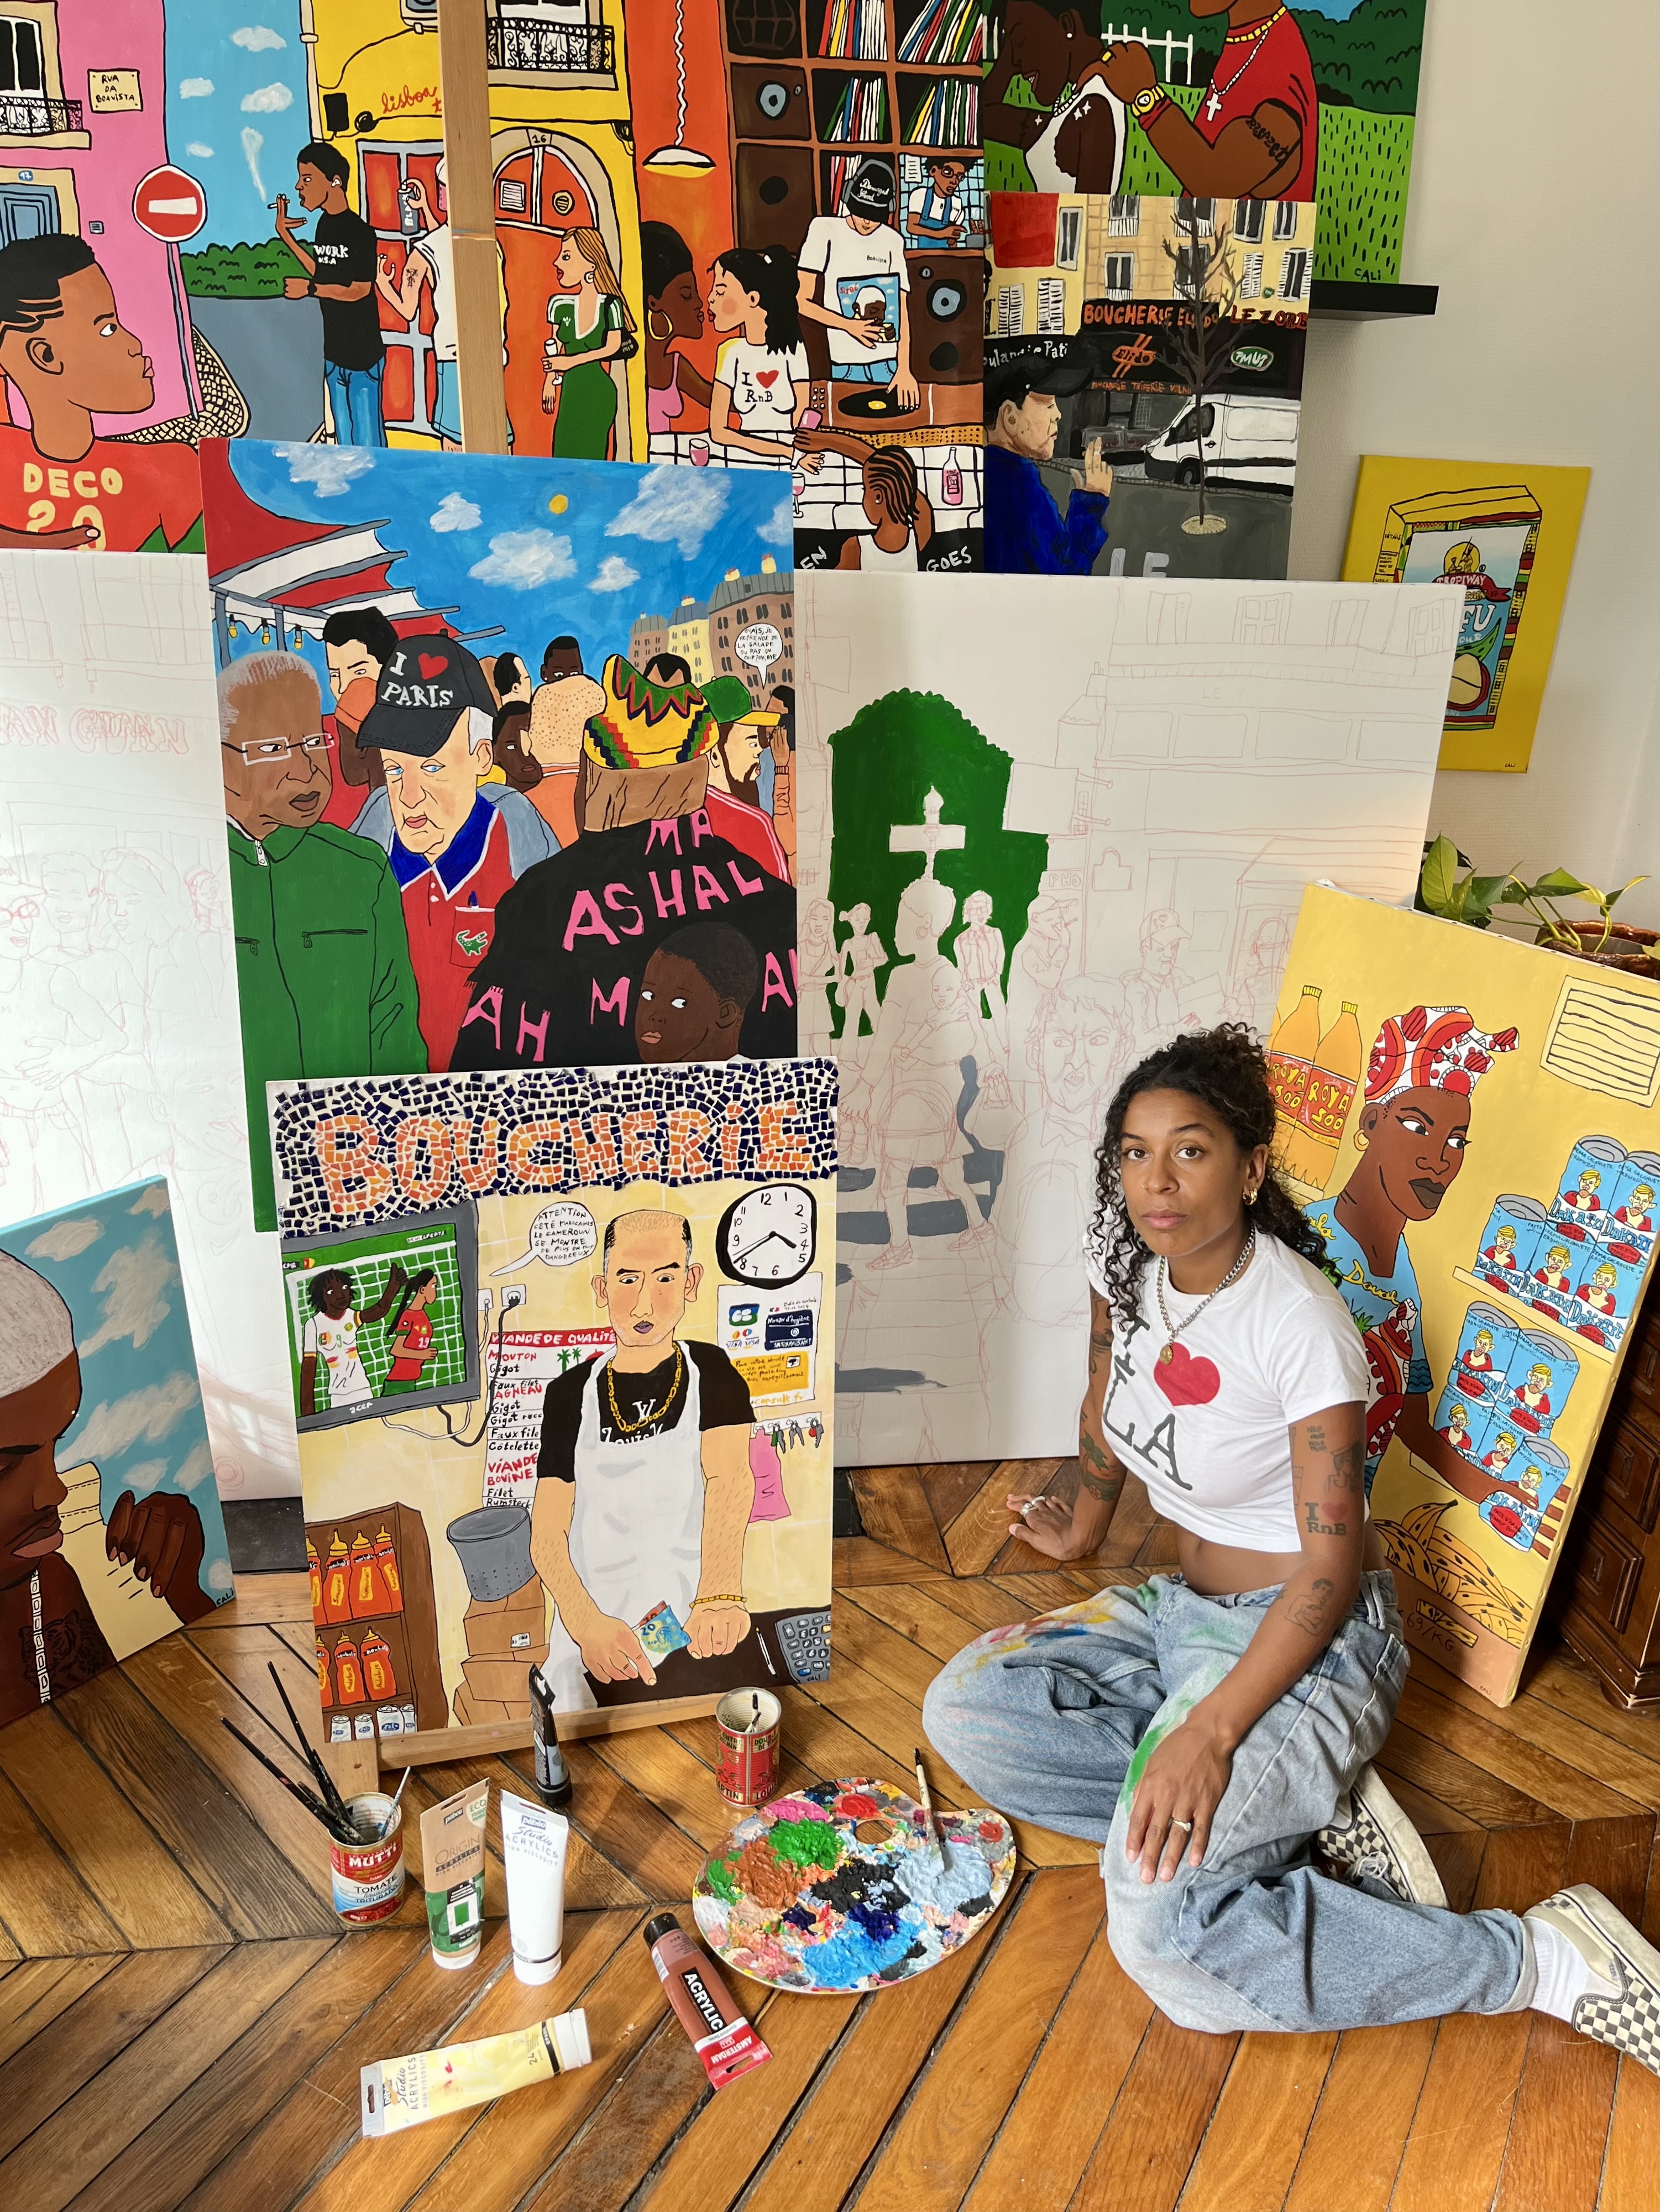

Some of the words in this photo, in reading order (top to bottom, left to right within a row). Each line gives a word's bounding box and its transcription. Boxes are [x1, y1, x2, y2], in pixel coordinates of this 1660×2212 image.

[102, 74, 119, 84] RUA
[96, 93, 135, 103] BOAVISTA
[381, 85, 437, 114] lisboa
[532, 134, 547, 144] 16
[20, 171, 32, 180] 17
[313, 244, 349, 258] WORK
[1083, 304, 1173, 327] BOUCHERIE
[1230, 305, 1256, 324] LE
[741, 373, 752, 386] I
[745, 389, 773, 403] RnB
[23, 462, 123, 497] DECO
[926, 546, 972, 572] GOES
[1436, 574, 1487, 585] TROPIWAY
[389, 652, 407, 676] I
[380, 682, 453, 707] PARIS
[645, 808, 714, 856] MA
[1307, 1081, 1350, 1113] ROYA
[315, 1102, 814, 1215] BOUCHERIE
[761, 1193, 772, 1205] 12
[784, 1191, 788, 1202] 1
[538, 1207, 587, 1221] ATTENTION
[741, 1206, 746, 1215] 11
[794, 1204, 804, 1217] 2
[734, 1218, 742, 1227] 10
[799, 1223, 808, 1234] 3
[732, 1234, 740, 1246] 9
[800, 1239, 809, 1251] 4
[545, 1250, 590, 1260] DANGEREUX
[798, 1254, 807, 1263] 5
[740, 1257, 747, 1270] 8
[752, 1266, 758, 1276] 7
[772, 1265, 779, 1276] 6
[491, 1333, 540, 1344] VIANDE
[544, 1334, 563, 1344] DE
[568, 1329, 616, 1344] QUALITÉ
[488, 1350, 537, 1361] MOUTON
[494, 1384, 542, 1399] AGNEAU
[349, 1402, 374, 1414] acer
[492, 1399, 520, 1416] Gigot
[491, 1412, 518, 1427] Gigot
[1102, 1360, 1193, 1491] LA
[491, 1428, 518, 1439] Faux
[488, 1453, 537, 1473] VIANDE
[488, 1469, 533, 1486] BOVINE
[487, 1487, 514, 1497] Filet
[1305, 1502, 1319, 1521] I
[1307, 1521, 1347, 1535] RnB
[640, 1623, 656, 1636] 20
[470, 1799, 486, 1813] ECO
[512, 1826, 553, 1846] Studio
[435, 1833, 481, 1865] ORIGIN
[505, 1835, 559, 1859] ACRYLICS
[349, 1842, 397, 1868] MUTTI
[437, 1846, 481, 1872] ACRYLICS
[452, 1852, 481, 1870] VISCOSITY
[524, 1848, 558, 1867] VISCOSITY
[354, 1872, 398, 1894] TOMATE
[355, 1884, 398, 1904] TRITURADO
[684, 1973, 724, 2031] ACRYLIC
[710, 2035, 752, 2064] AMSTERDAM
[396, 2067, 409, 2106] Studio
[409, 2056, 420, 2110] ACRYLICS
